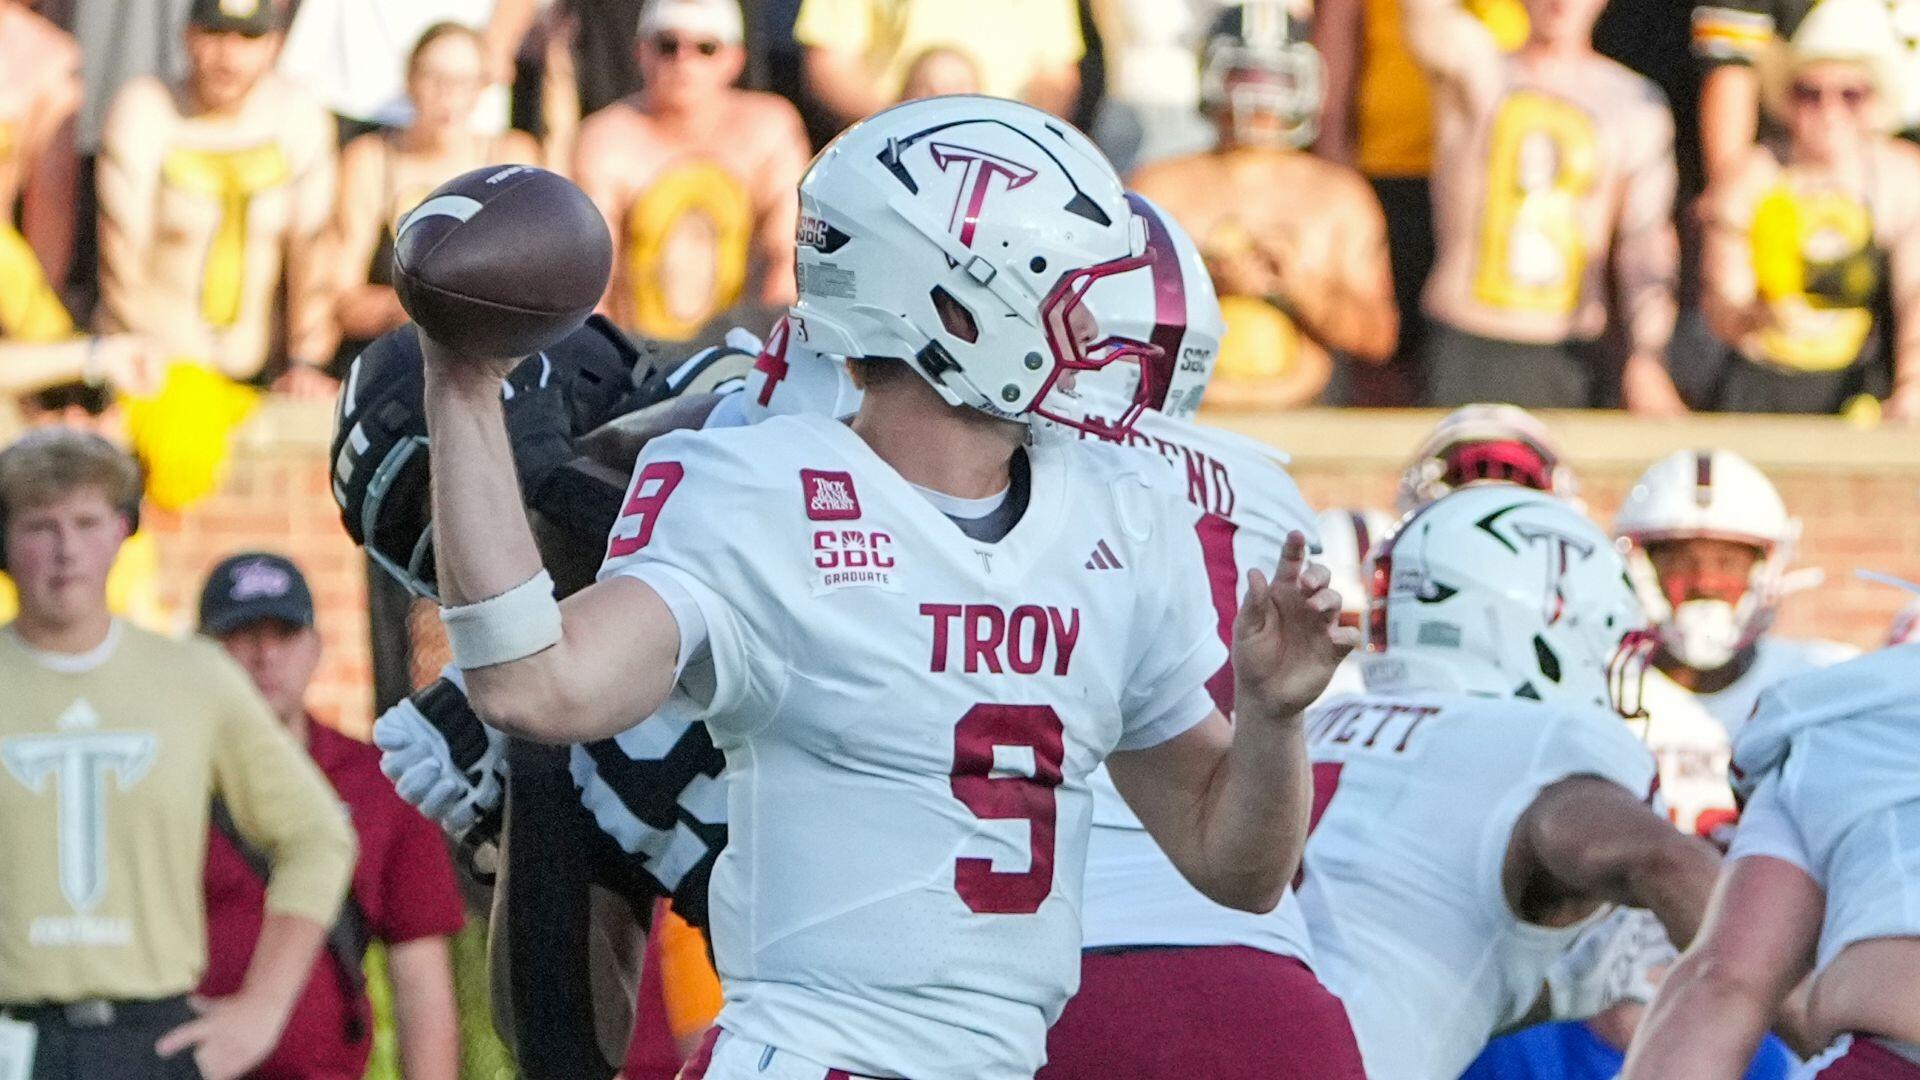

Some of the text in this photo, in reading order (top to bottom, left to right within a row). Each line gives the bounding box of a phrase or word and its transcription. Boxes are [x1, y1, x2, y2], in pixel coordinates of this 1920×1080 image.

[164, 140, 288, 328] T
[608, 461, 684, 560] 9
[812, 477, 845, 493] TROY
[814, 531, 894, 568] SBC
[824, 571, 890, 586] GRADUATE
[919, 603, 1080, 676] TROY
[949, 702, 1064, 914] 9
